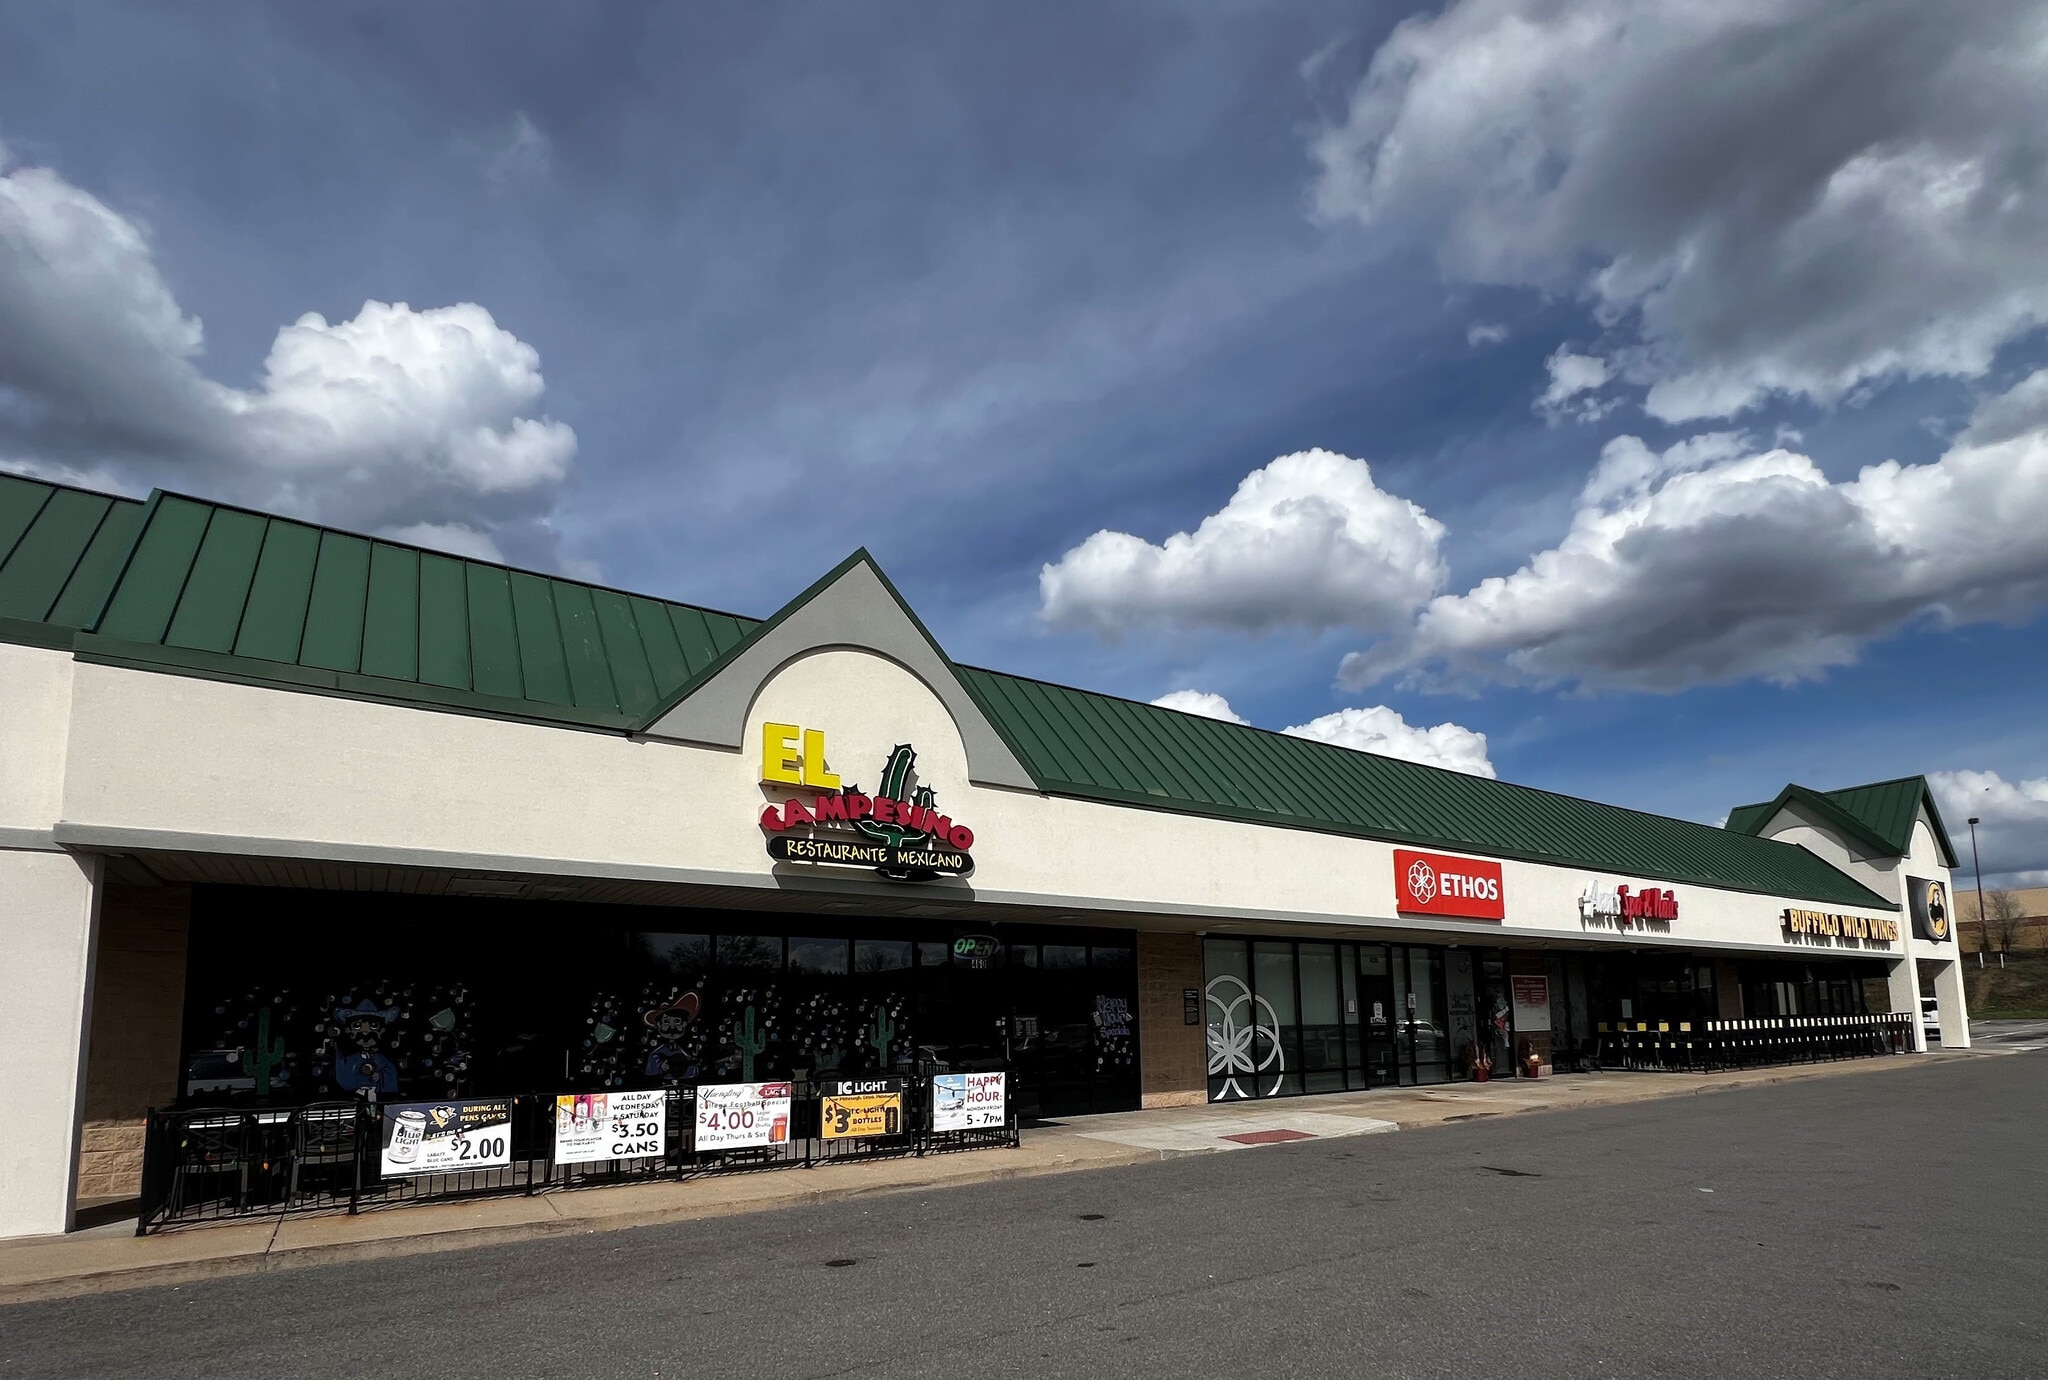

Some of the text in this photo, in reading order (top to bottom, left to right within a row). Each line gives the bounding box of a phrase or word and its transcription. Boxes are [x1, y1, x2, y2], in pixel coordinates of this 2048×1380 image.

[762, 721, 841, 790] EL
[761, 794, 975, 850] CAMPESINO
[786, 839, 963, 869] RESTAURANTE MEXICANO
[1439, 872, 1498, 901] ETHOS
[1789, 908, 1899, 942] BUFFALO WILD WINGS
[953, 937, 994, 955] OPEN
[837, 1080, 888, 1095] IC LIGHT
[636, 1093, 651, 1101] DAY
[966, 1091, 1003, 1103] HOUR:
[462, 1103, 507, 1113] DURING ALL
[612, 1101, 660, 1111] WEDNESDAY
[460, 1113, 480, 1121] PENS
[620, 1111, 659, 1120] SATURDAY
[699, 1110, 754, 1131] $4.00
[825, 1104, 851, 1133] $3
[852, 1116, 882, 1125] BOTTLES
[966, 1114, 973, 1125] 5
[983, 1112, 1002, 1124] 7PM
[612, 1122, 659, 1138] $3.50
[395, 1136, 420, 1145] LIGHT
[710, 1134, 724, 1142] Day
[451, 1137, 505, 1160] $2.00
[612, 1140, 659, 1155] CANS
